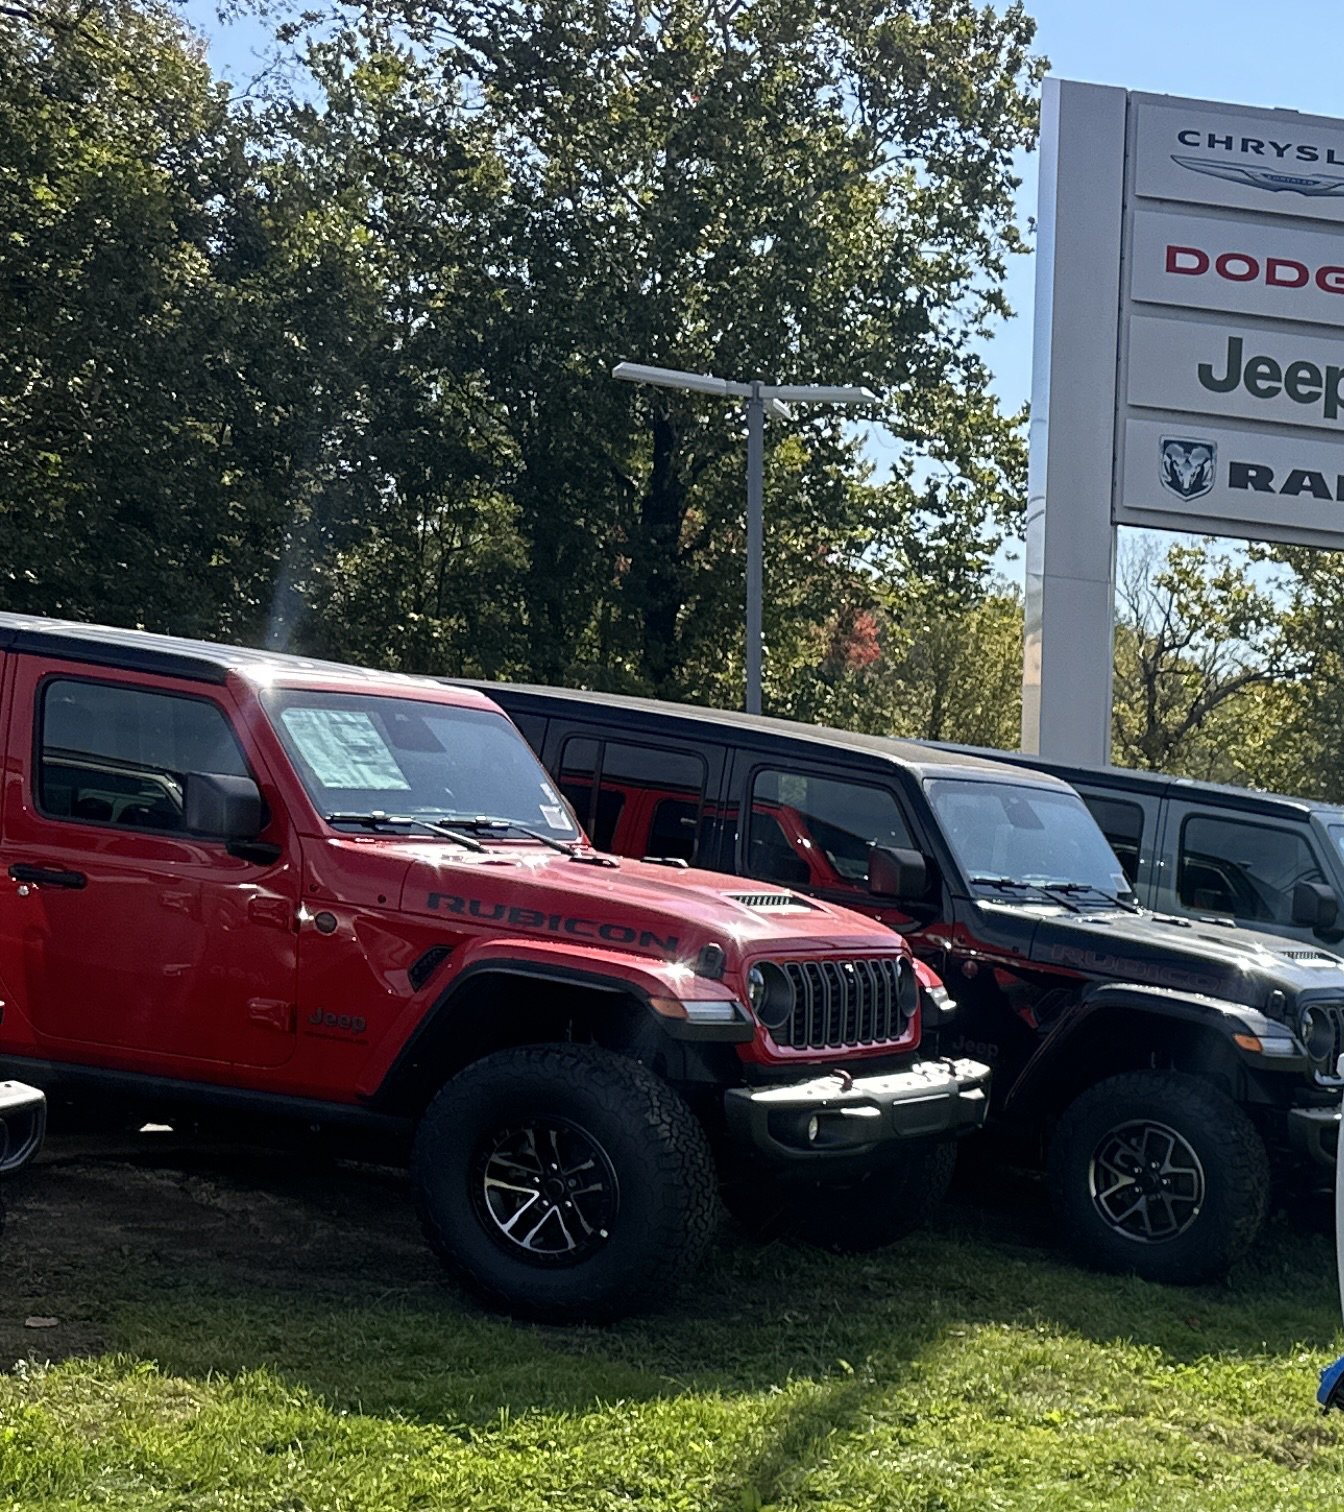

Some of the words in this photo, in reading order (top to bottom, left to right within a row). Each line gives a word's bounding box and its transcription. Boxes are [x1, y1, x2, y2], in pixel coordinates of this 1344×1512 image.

[426, 891, 681, 952] RUBICON
[307, 1007, 367, 1035] Jeep
[952, 1035, 1000, 1060] Jeep
